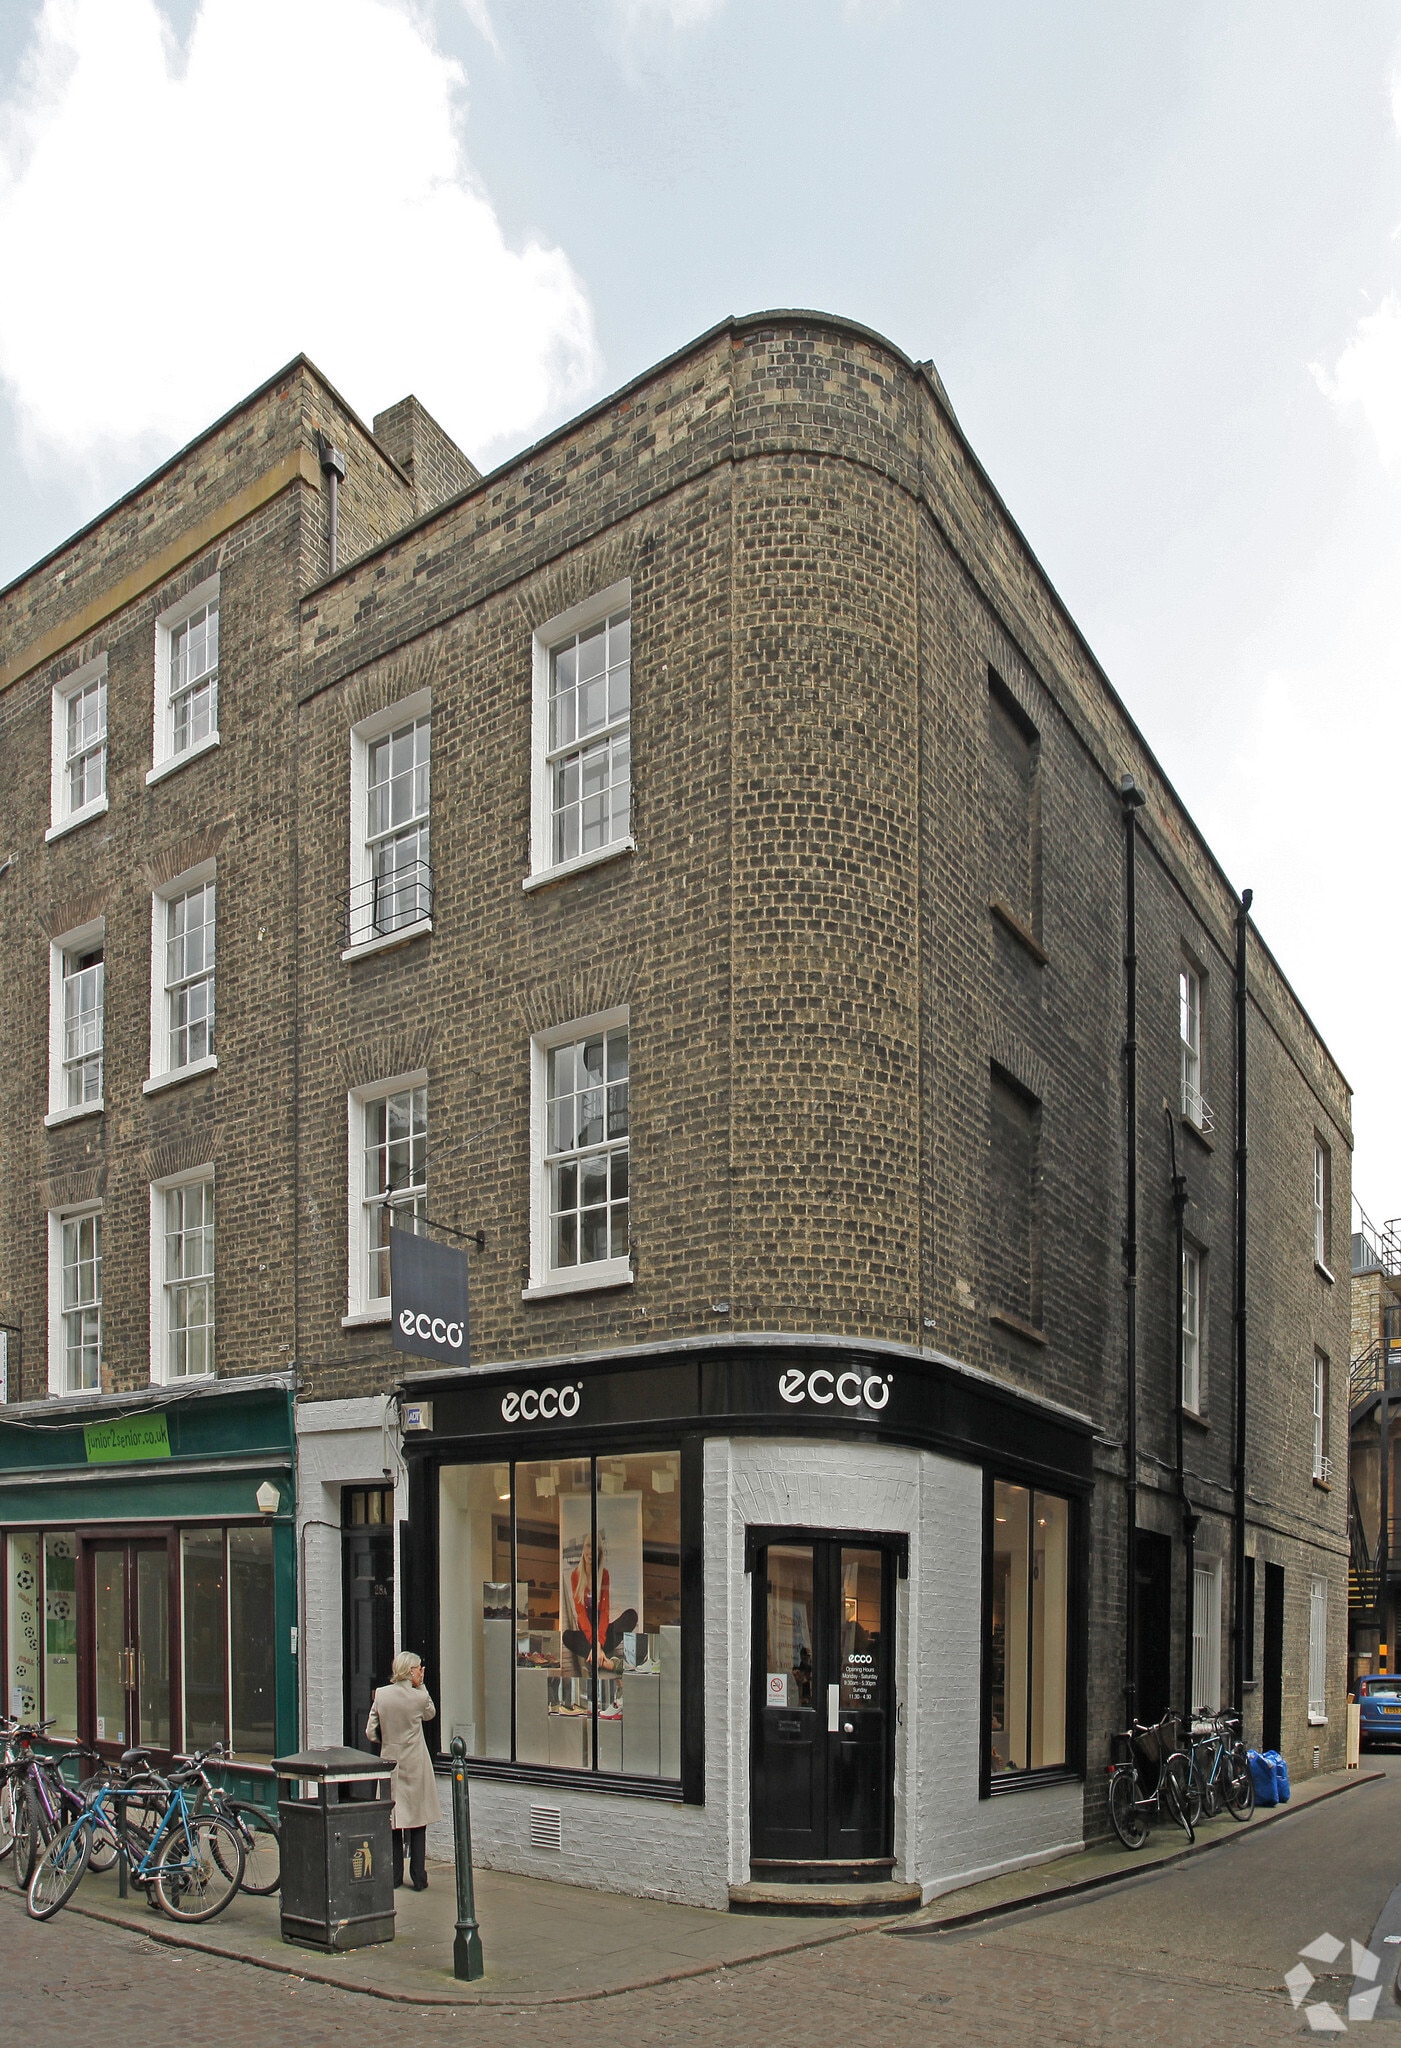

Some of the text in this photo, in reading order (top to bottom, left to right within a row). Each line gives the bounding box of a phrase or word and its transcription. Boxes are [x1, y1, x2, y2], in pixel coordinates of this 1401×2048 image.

[400, 1309, 464, 1348] ecco
[501, 1381, 583, 1422] ecco
[779, 1369, 894, 1409] ecco
[408, 1410, 422, 1421] ADT
[87, 1424, 167, 1455] junior2senior.co.uk
[848, 1654, 873, 1664] ecco
